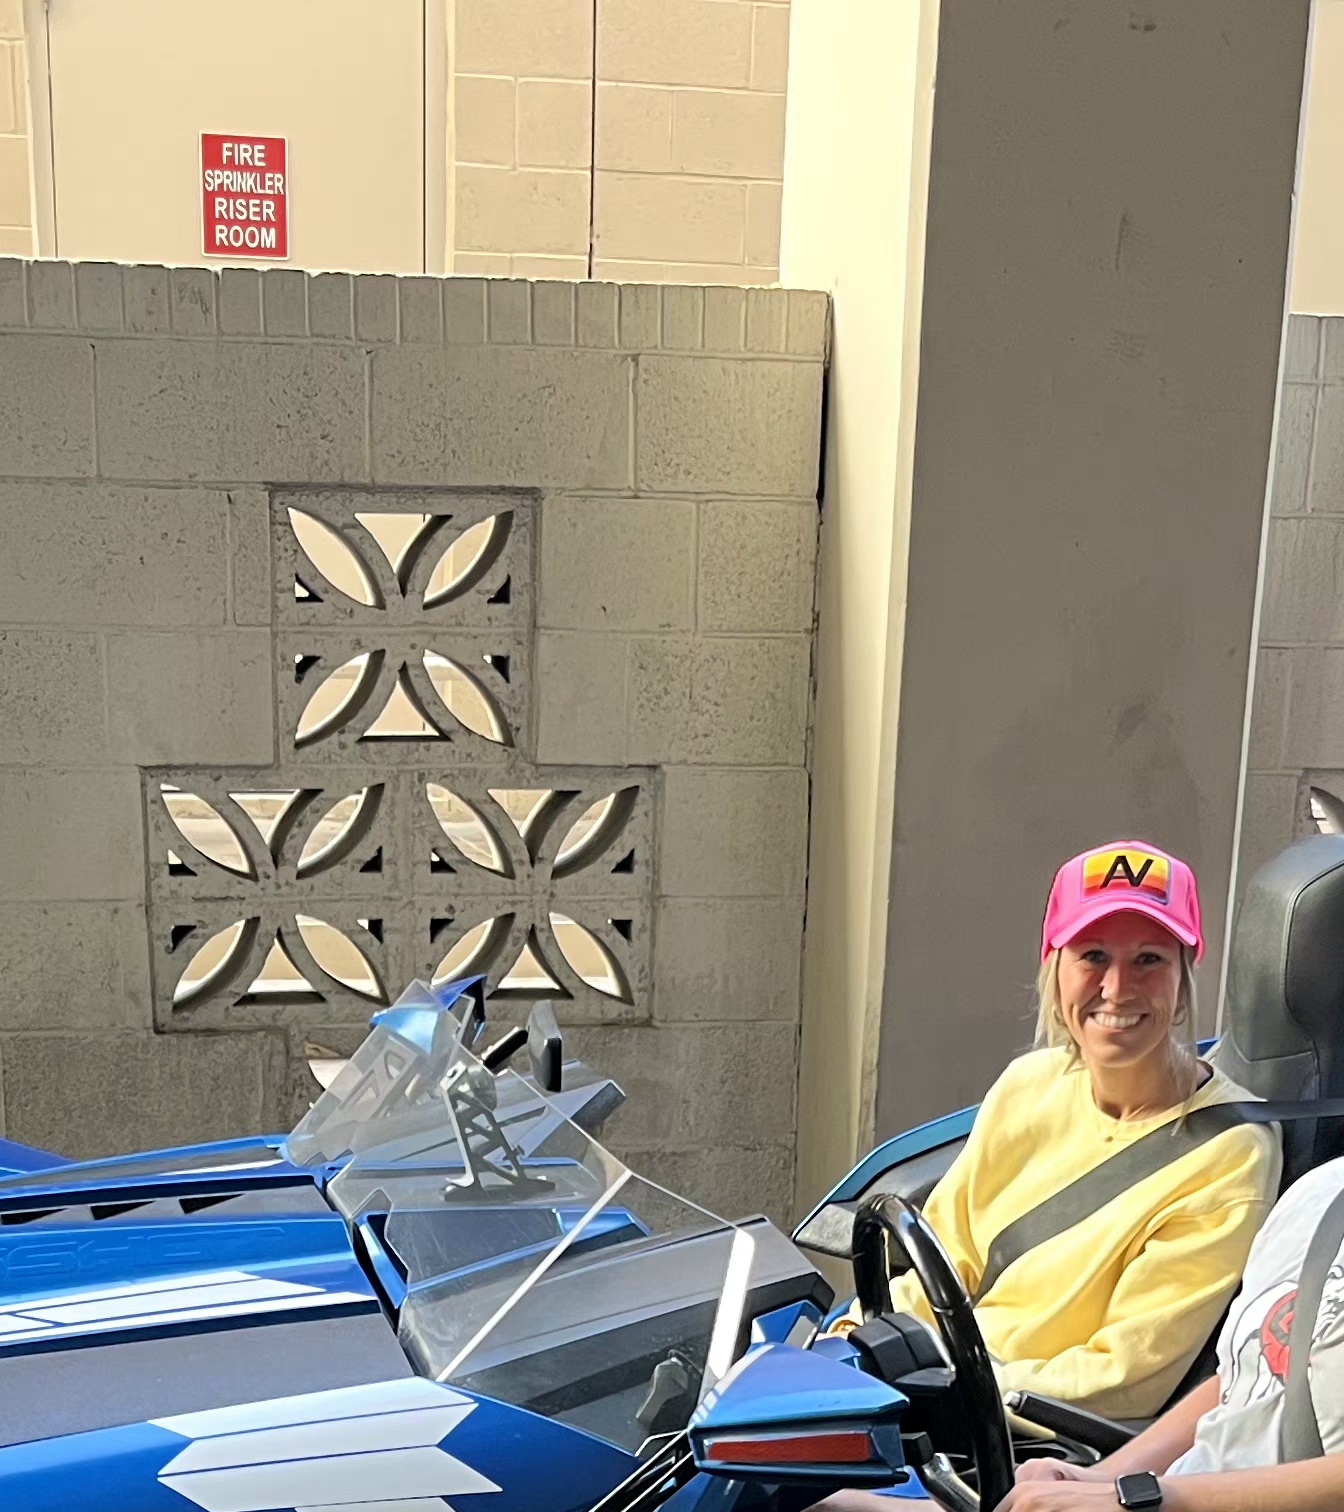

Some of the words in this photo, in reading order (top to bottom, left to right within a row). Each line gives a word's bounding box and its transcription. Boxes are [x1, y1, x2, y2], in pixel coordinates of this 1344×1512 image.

[222, 142, 266, 167] FIRE
[204, 169, 284, 195] SPRINKLER
[214, 197, 276, 222] RISER
[215, 224, 276, 249] ROOM
[1099, 855, 1155, 890] AV
